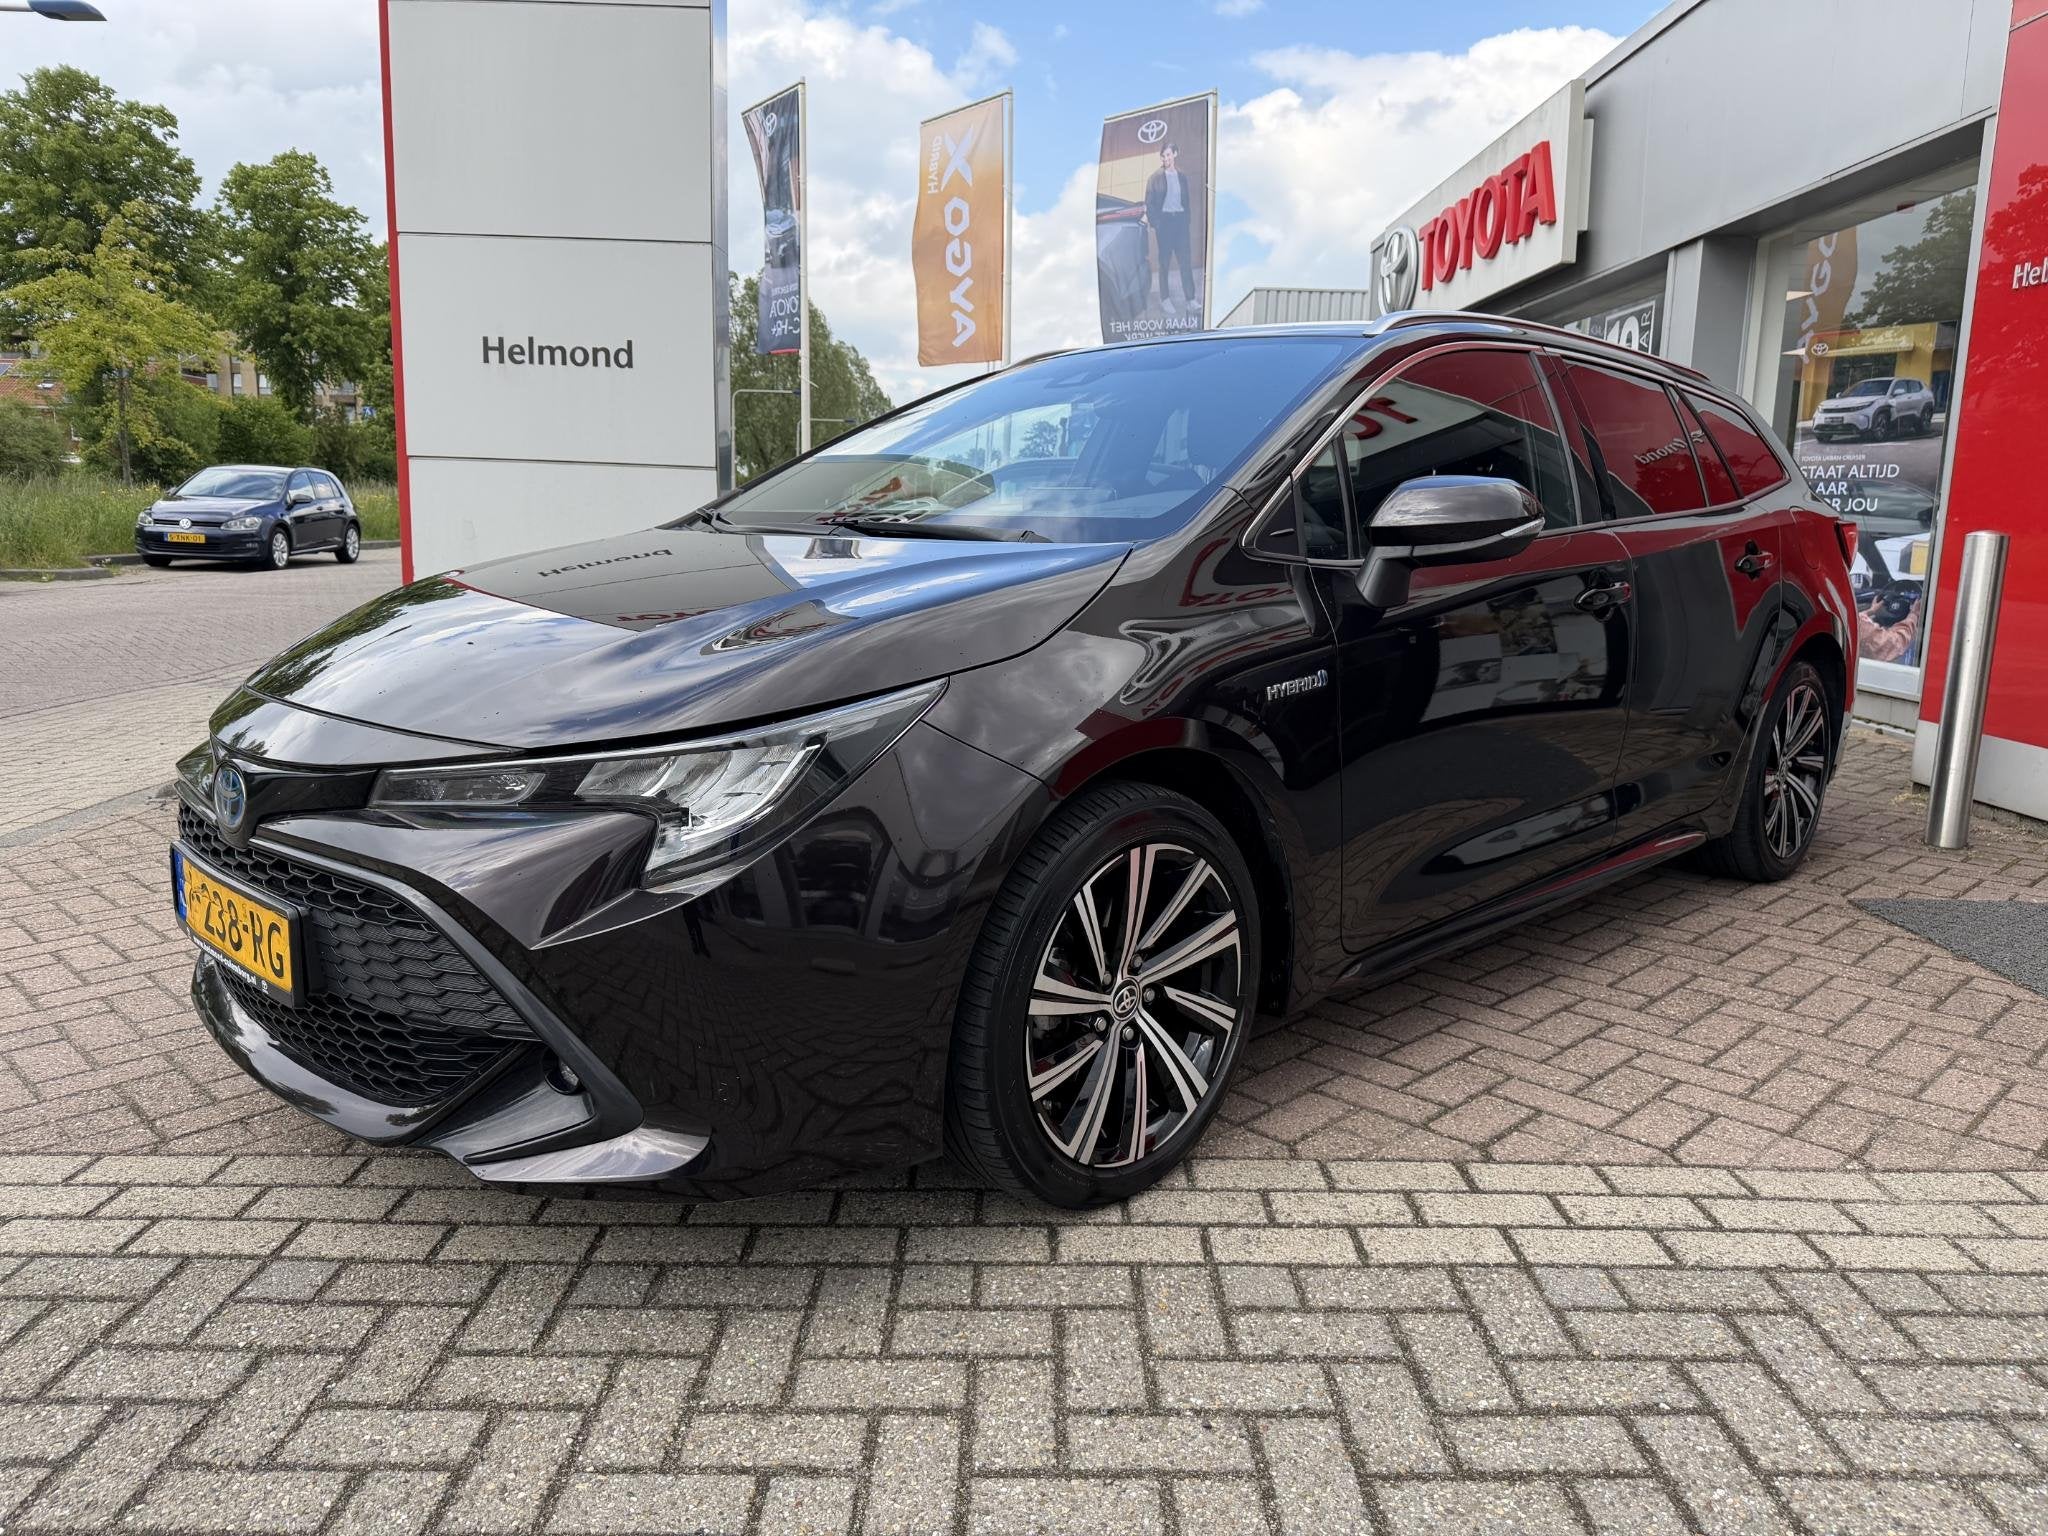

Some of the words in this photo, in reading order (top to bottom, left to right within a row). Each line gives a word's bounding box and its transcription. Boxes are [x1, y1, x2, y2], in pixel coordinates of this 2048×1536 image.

[1418, 140, 1556, 291] TOYOTA
[481, 336, 633, 369] Helmond
[1800, 465, 1845, 479] STAAT
[1848, 464, 1899, 478] ALTIJD
[1844, 498, 1878, 512] JOU
[1266, 675, 1318, 701] HYBRID
